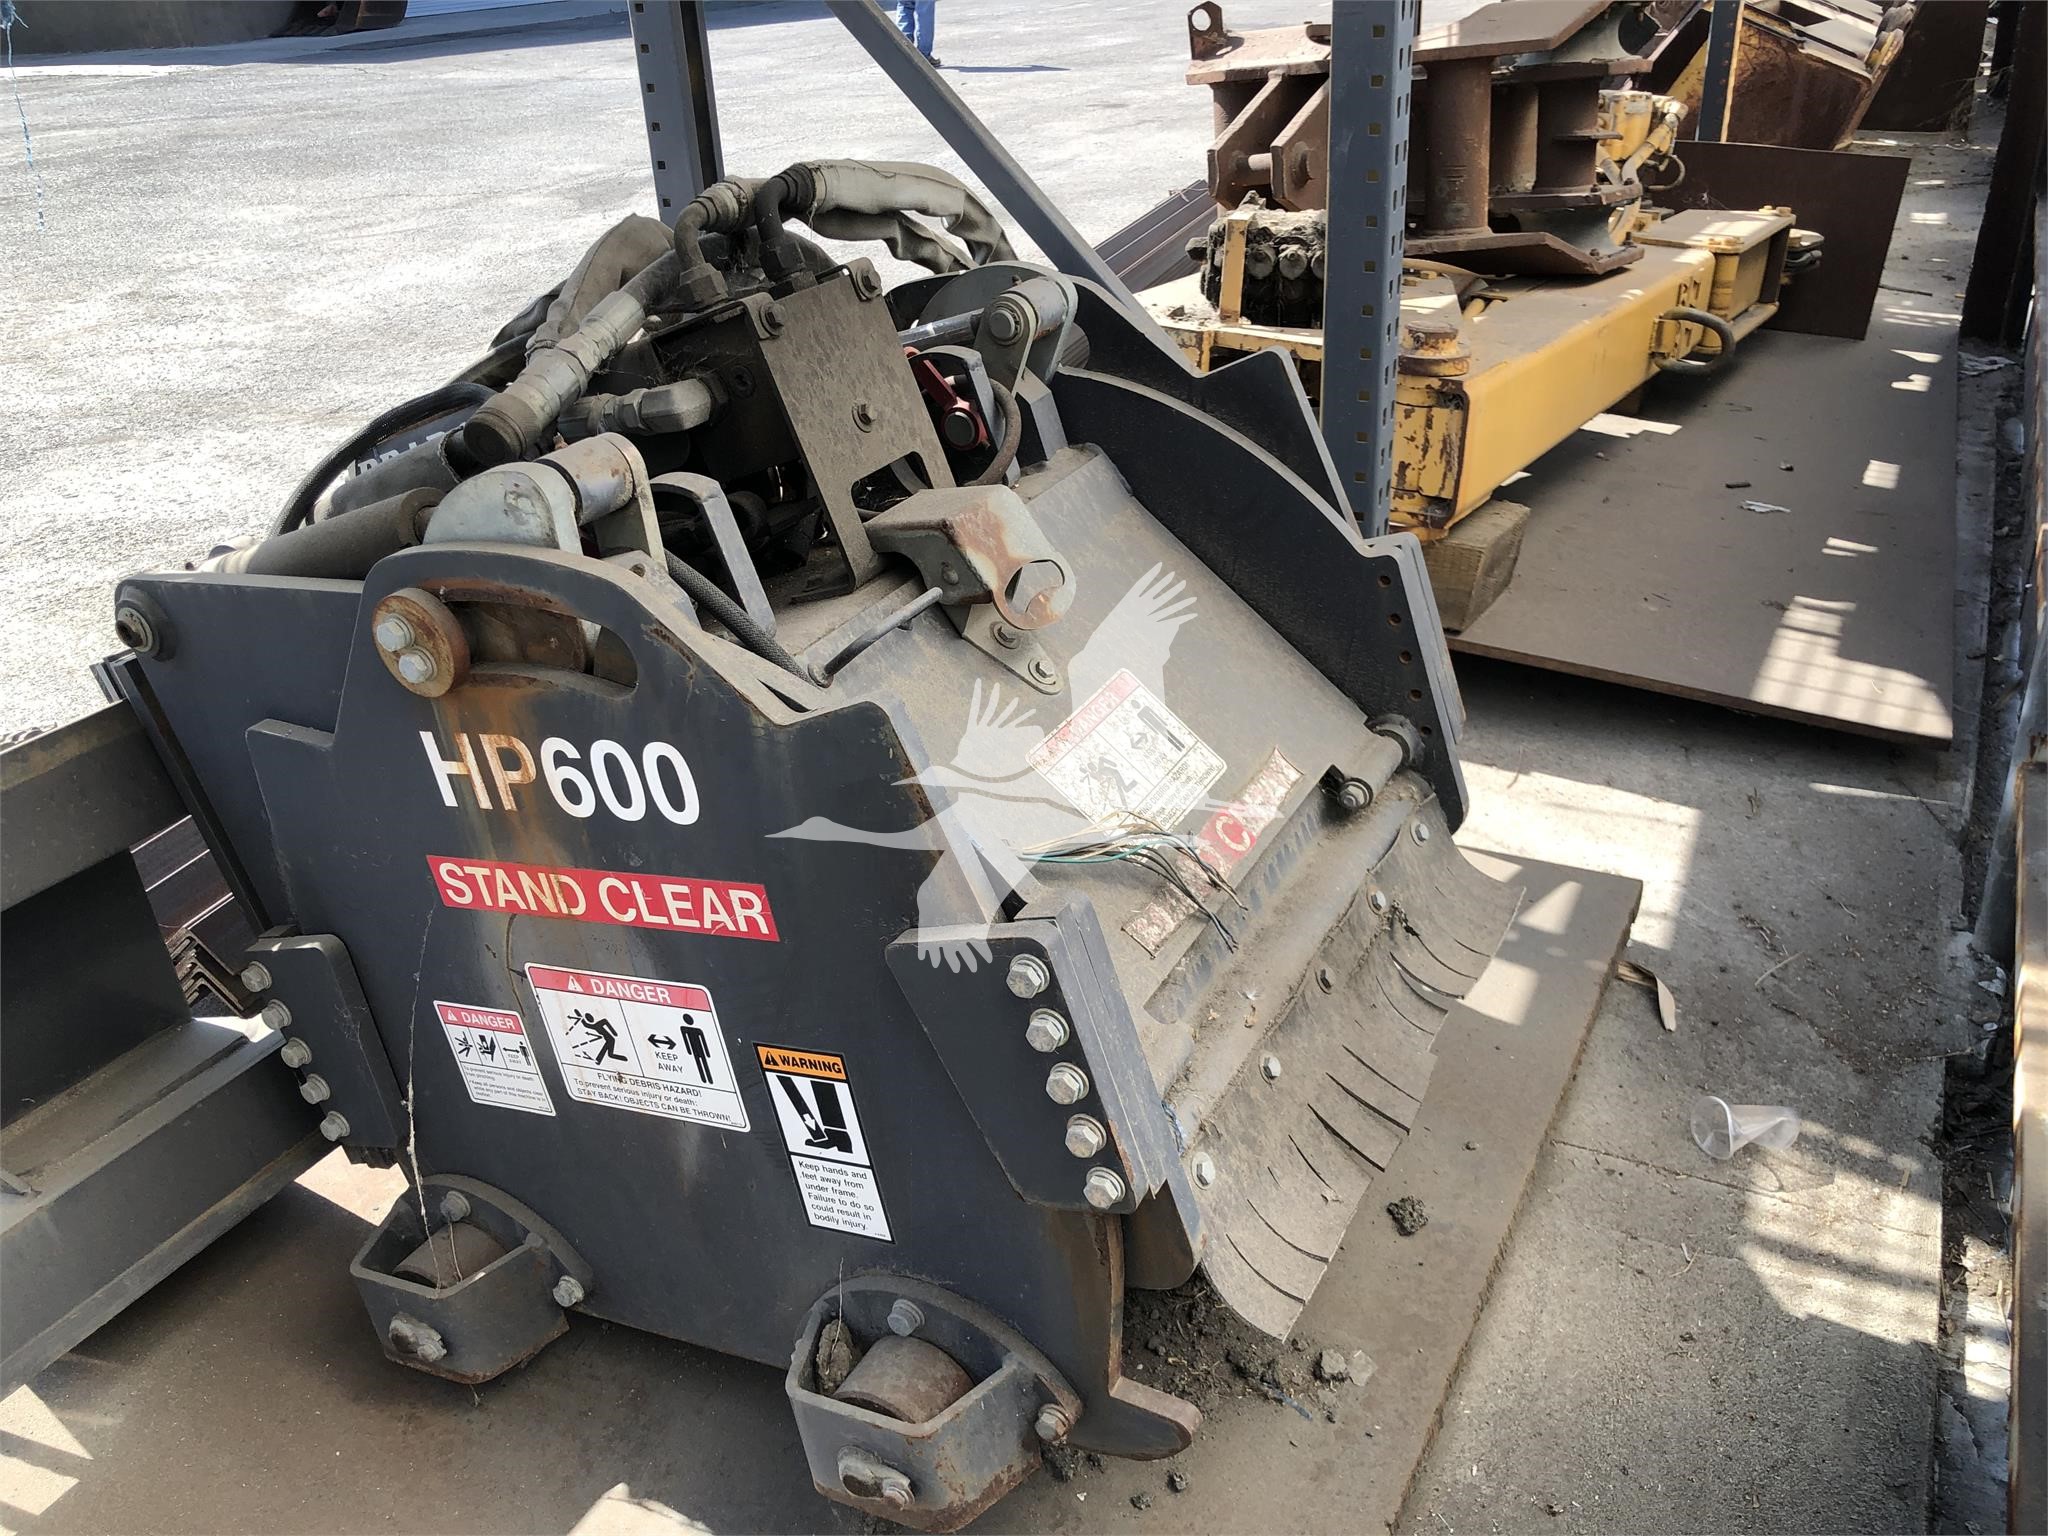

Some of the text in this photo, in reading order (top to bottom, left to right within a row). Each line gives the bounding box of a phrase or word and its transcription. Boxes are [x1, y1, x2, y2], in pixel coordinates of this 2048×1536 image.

[419, 731, 700, 825] HP600
[439, 862, 769, 935] STAND CLEAR
[590, 978, 671, 1004] DANGER
[461, 1012, 515, 1029] DANGER
[655, 1052, 678, 1061] KEEP
[779, 1054, 842, 1073] WARNING
[658, 1063, 683, 1074] AWAY
[574, 1078, 584, 1086] To
[583, 1080, 612, 1092] prevent
[613, 1086, 640, 1096] serious
[641, 1090, 662, 1103] injury
[663, 1094, 673, 1103] or
[597, 1073, 702, 1097] FLYING DEBRIS HAZARD!
[577, 1088, 731, 1122] STAY BACK! OBJECTS CAN BE THROWN!
[798, 1161, 867, 1179] Keep hands and
[805, 1183, 829, 1193] under
[820, 1175, 841, 1186] away
[844, 1179, 864, 1189] from
[808, 1193, 836, 1204] Failure
[838, 1198, 847, 1206] to
[850, 1200, 861, 1209] do
[811, 1203, 872, 1220] could result in
[814, 1213, 839, 1225] bodily
